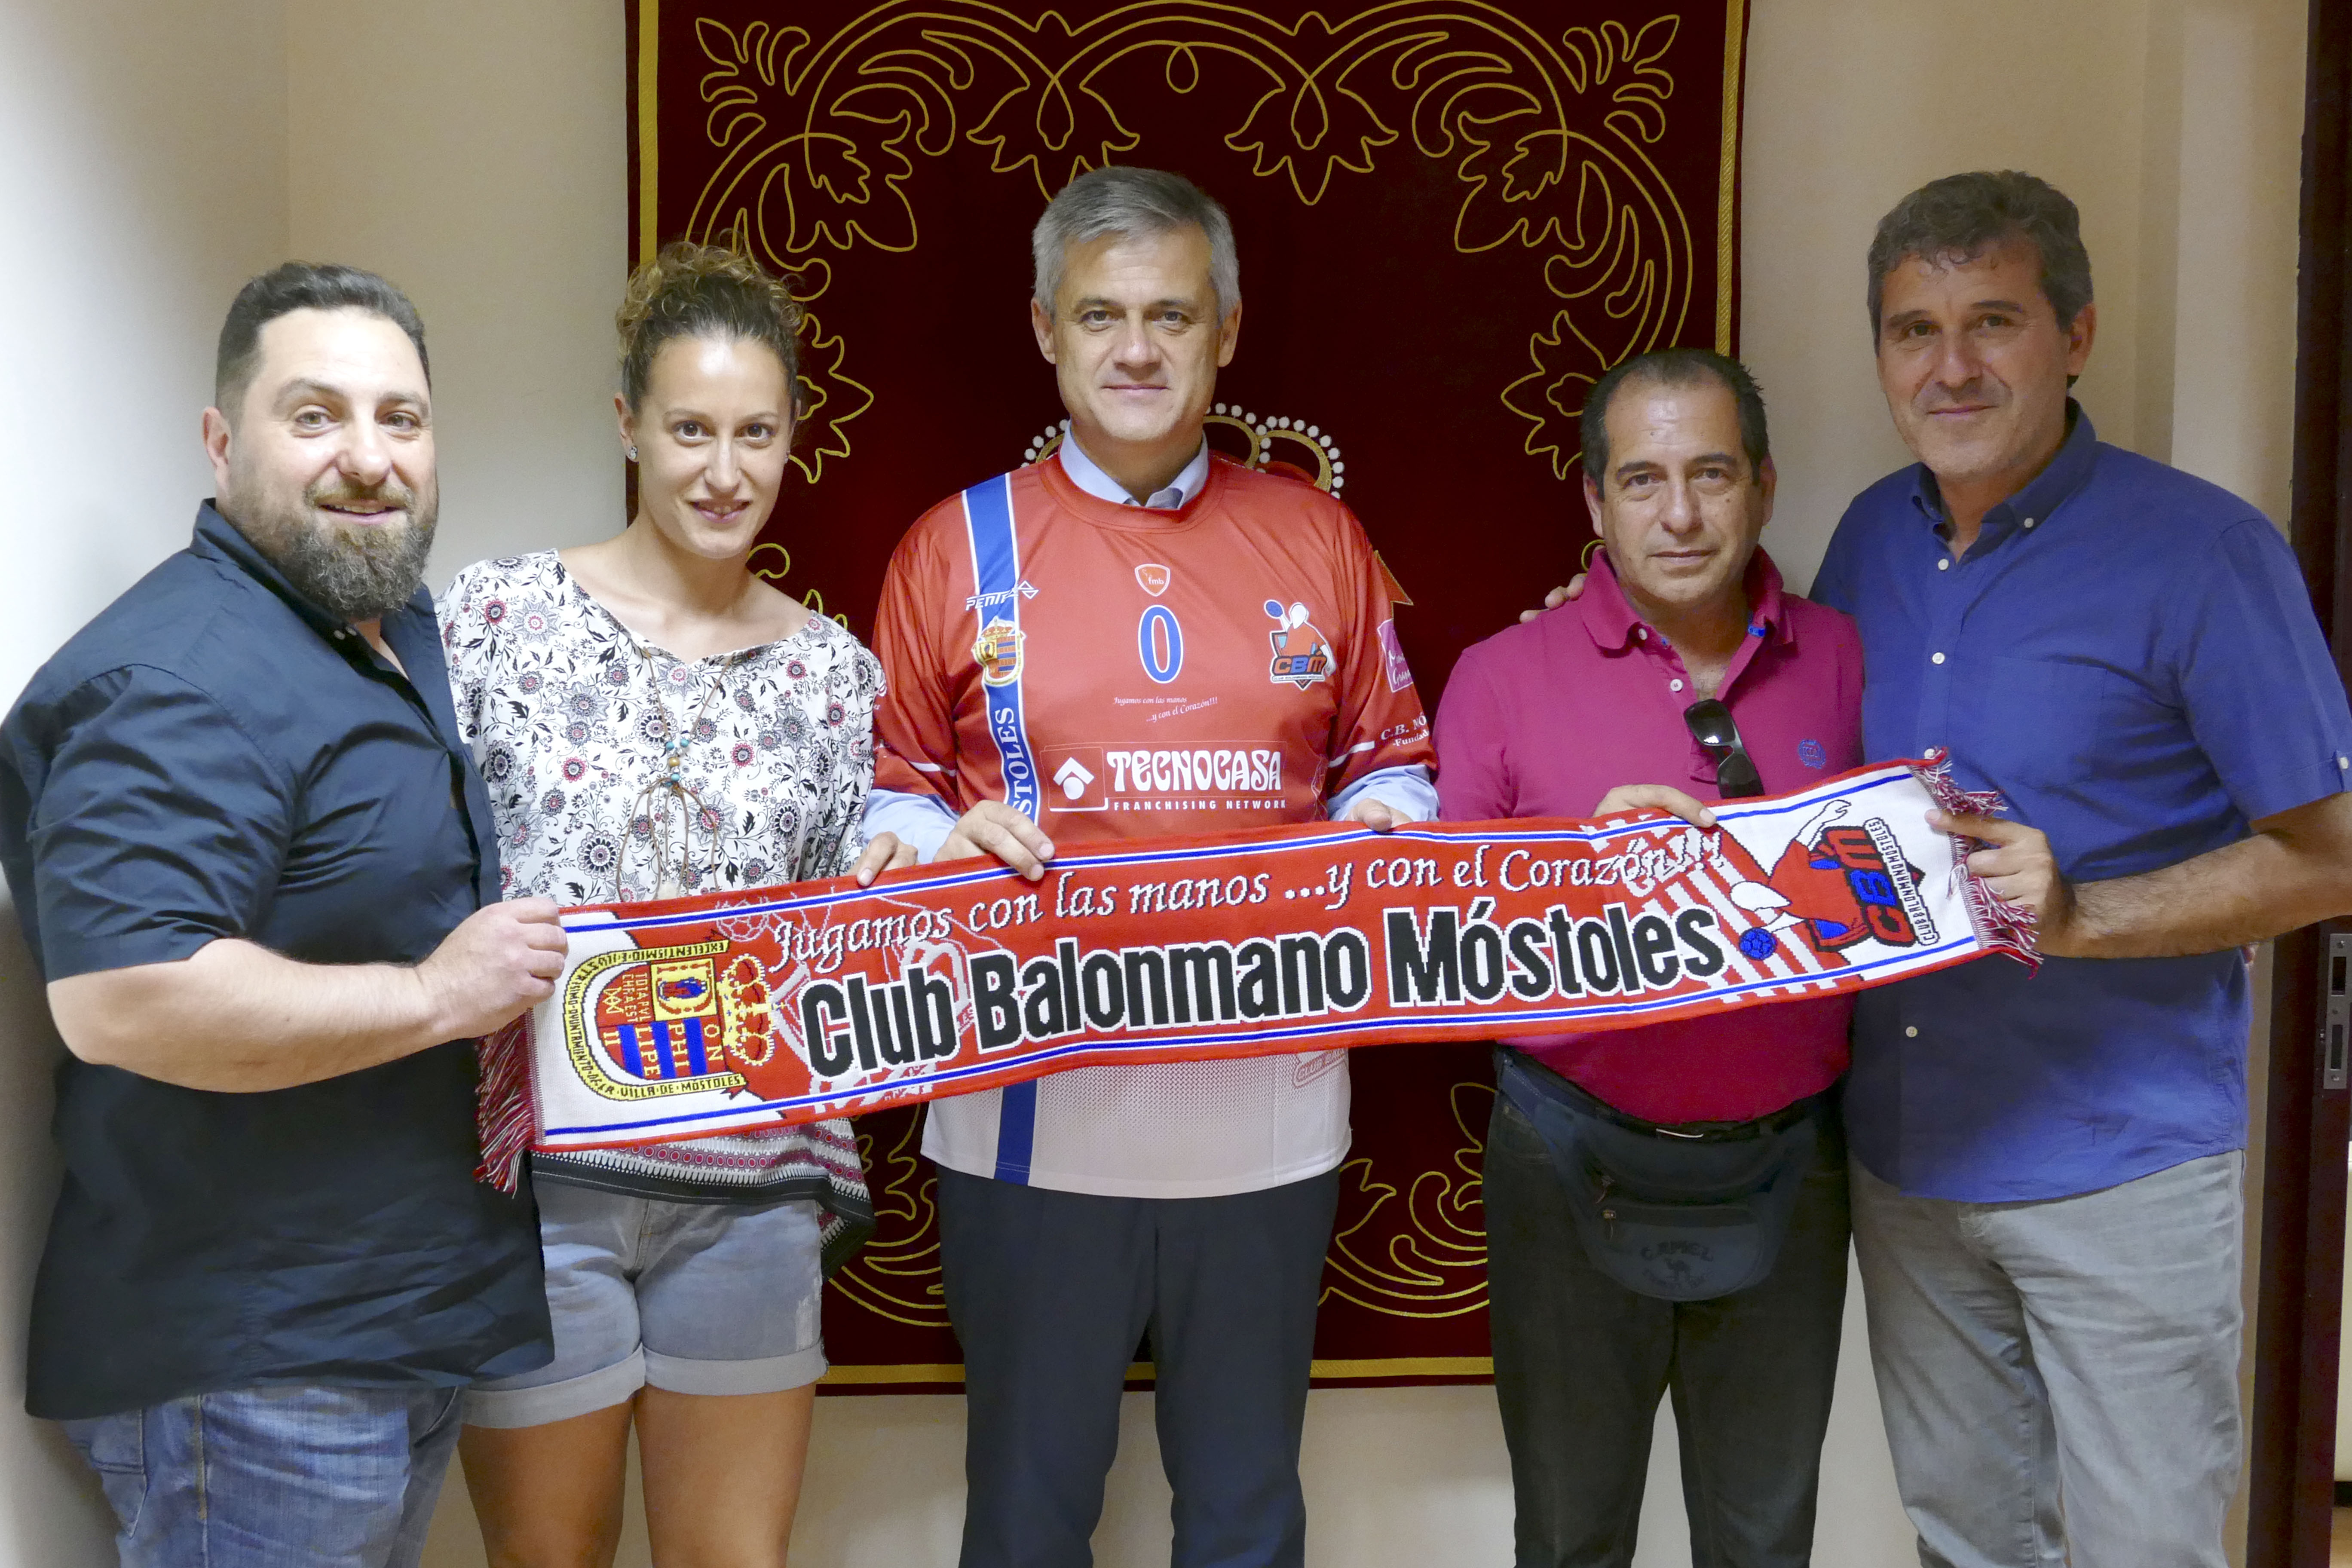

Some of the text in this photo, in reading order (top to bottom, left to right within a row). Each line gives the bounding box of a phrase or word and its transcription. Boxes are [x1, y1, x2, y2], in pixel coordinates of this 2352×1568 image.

[1138, 604, 1184, 684] 0
[1274, 656, 1327, 674] CBM
[1155, 695, 1165, 704] las
[1158, 710, 1170, 719] con
[1172, 705, 1179, 715] el
[1106, 750, 1281, 792] TECNOCASA
[1114, 799, 1286, 811] FRANCHISING NETWORK
[1827, 830, 1916, 943] CBM
[1892, 864, 1925, 918] BALONMANO
[769, 908, 953, 974] Jugamos
[968, 893, 1044, 933] con
[1055, 871, 1118, 918] las
[1128, 873, 1271, 915] manos
[1366, 854, 1443, 889] con
[1453, 845, 1492, 888] el
[1914, 919, 1936, 941] CLUB
[798, 896, 1726, 1081] Club Balonmano Móstoles
[621, 1086, 655, 1098] VILLA
[660, 1084, 674, 1093] DE
